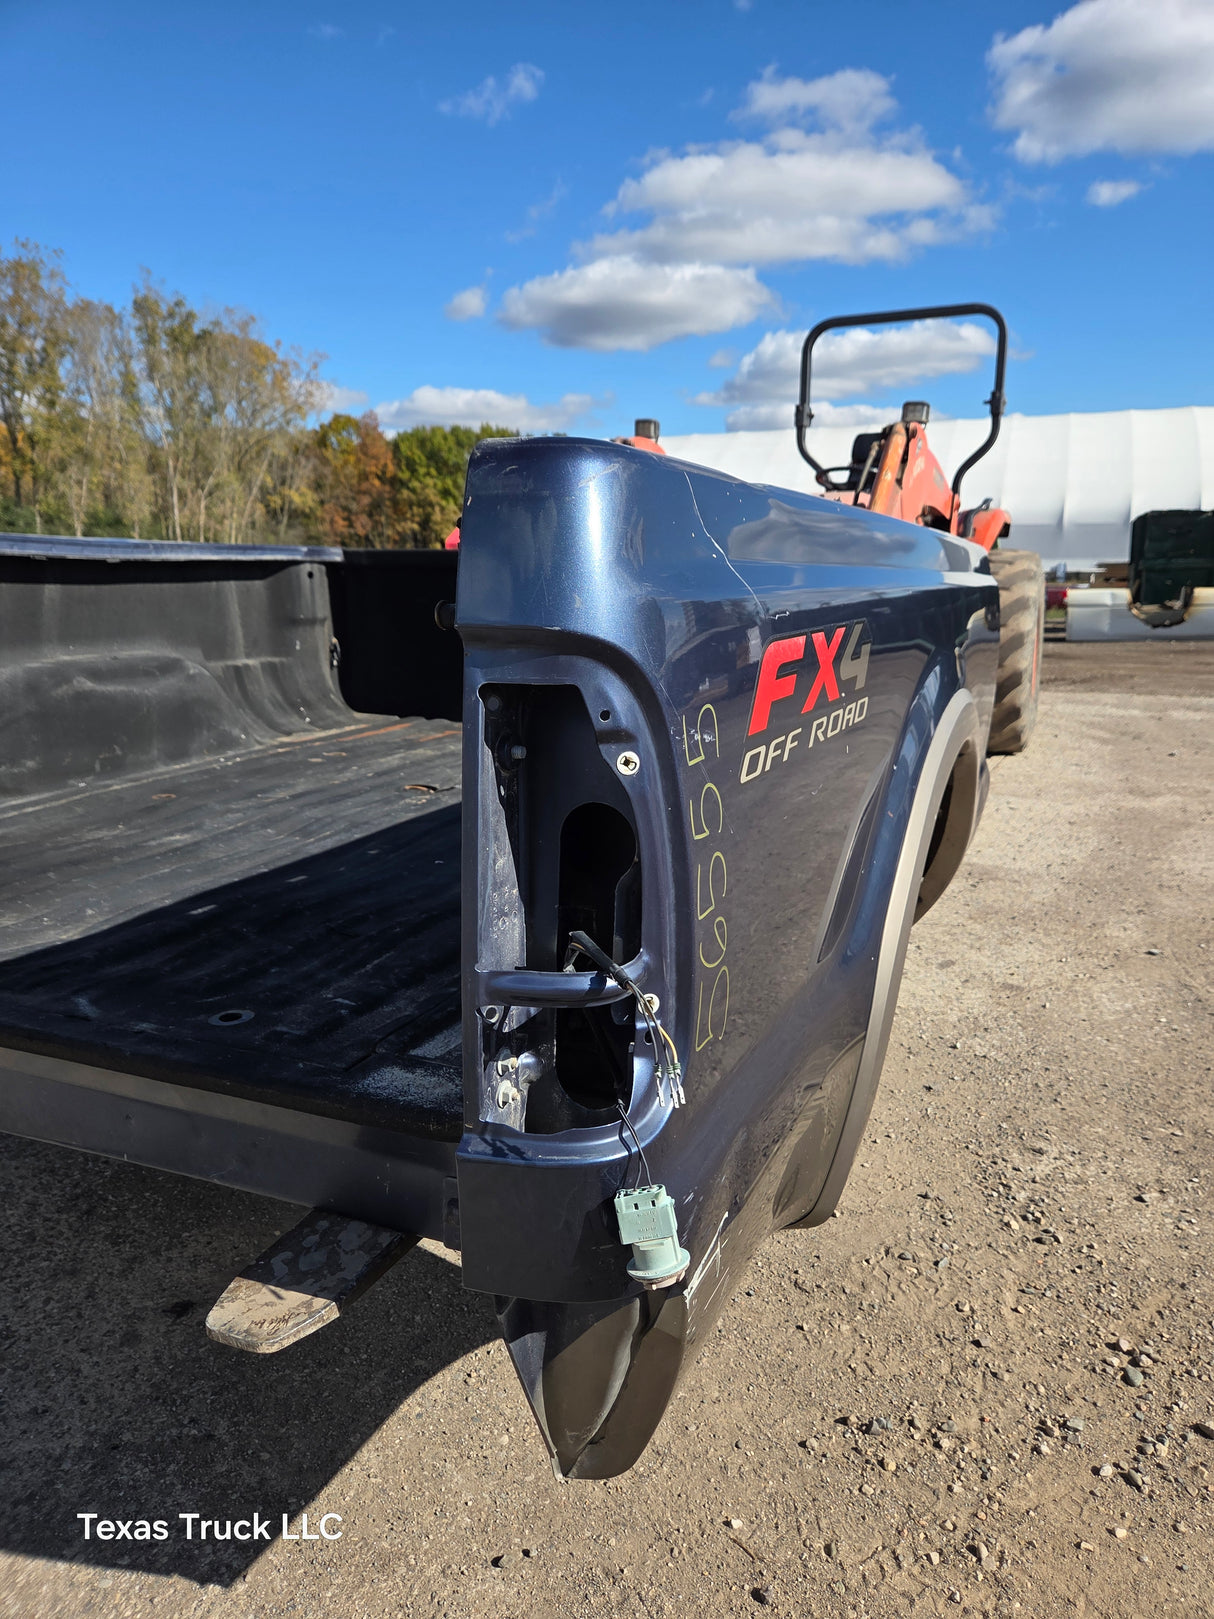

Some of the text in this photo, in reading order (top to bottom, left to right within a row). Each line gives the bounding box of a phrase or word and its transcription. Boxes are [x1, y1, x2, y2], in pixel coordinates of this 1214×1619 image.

[748, 622, 871, 736] FX4
[740, 697, 869, 784] OFF ROAD
[682, 704, 729, 1052] 56555
